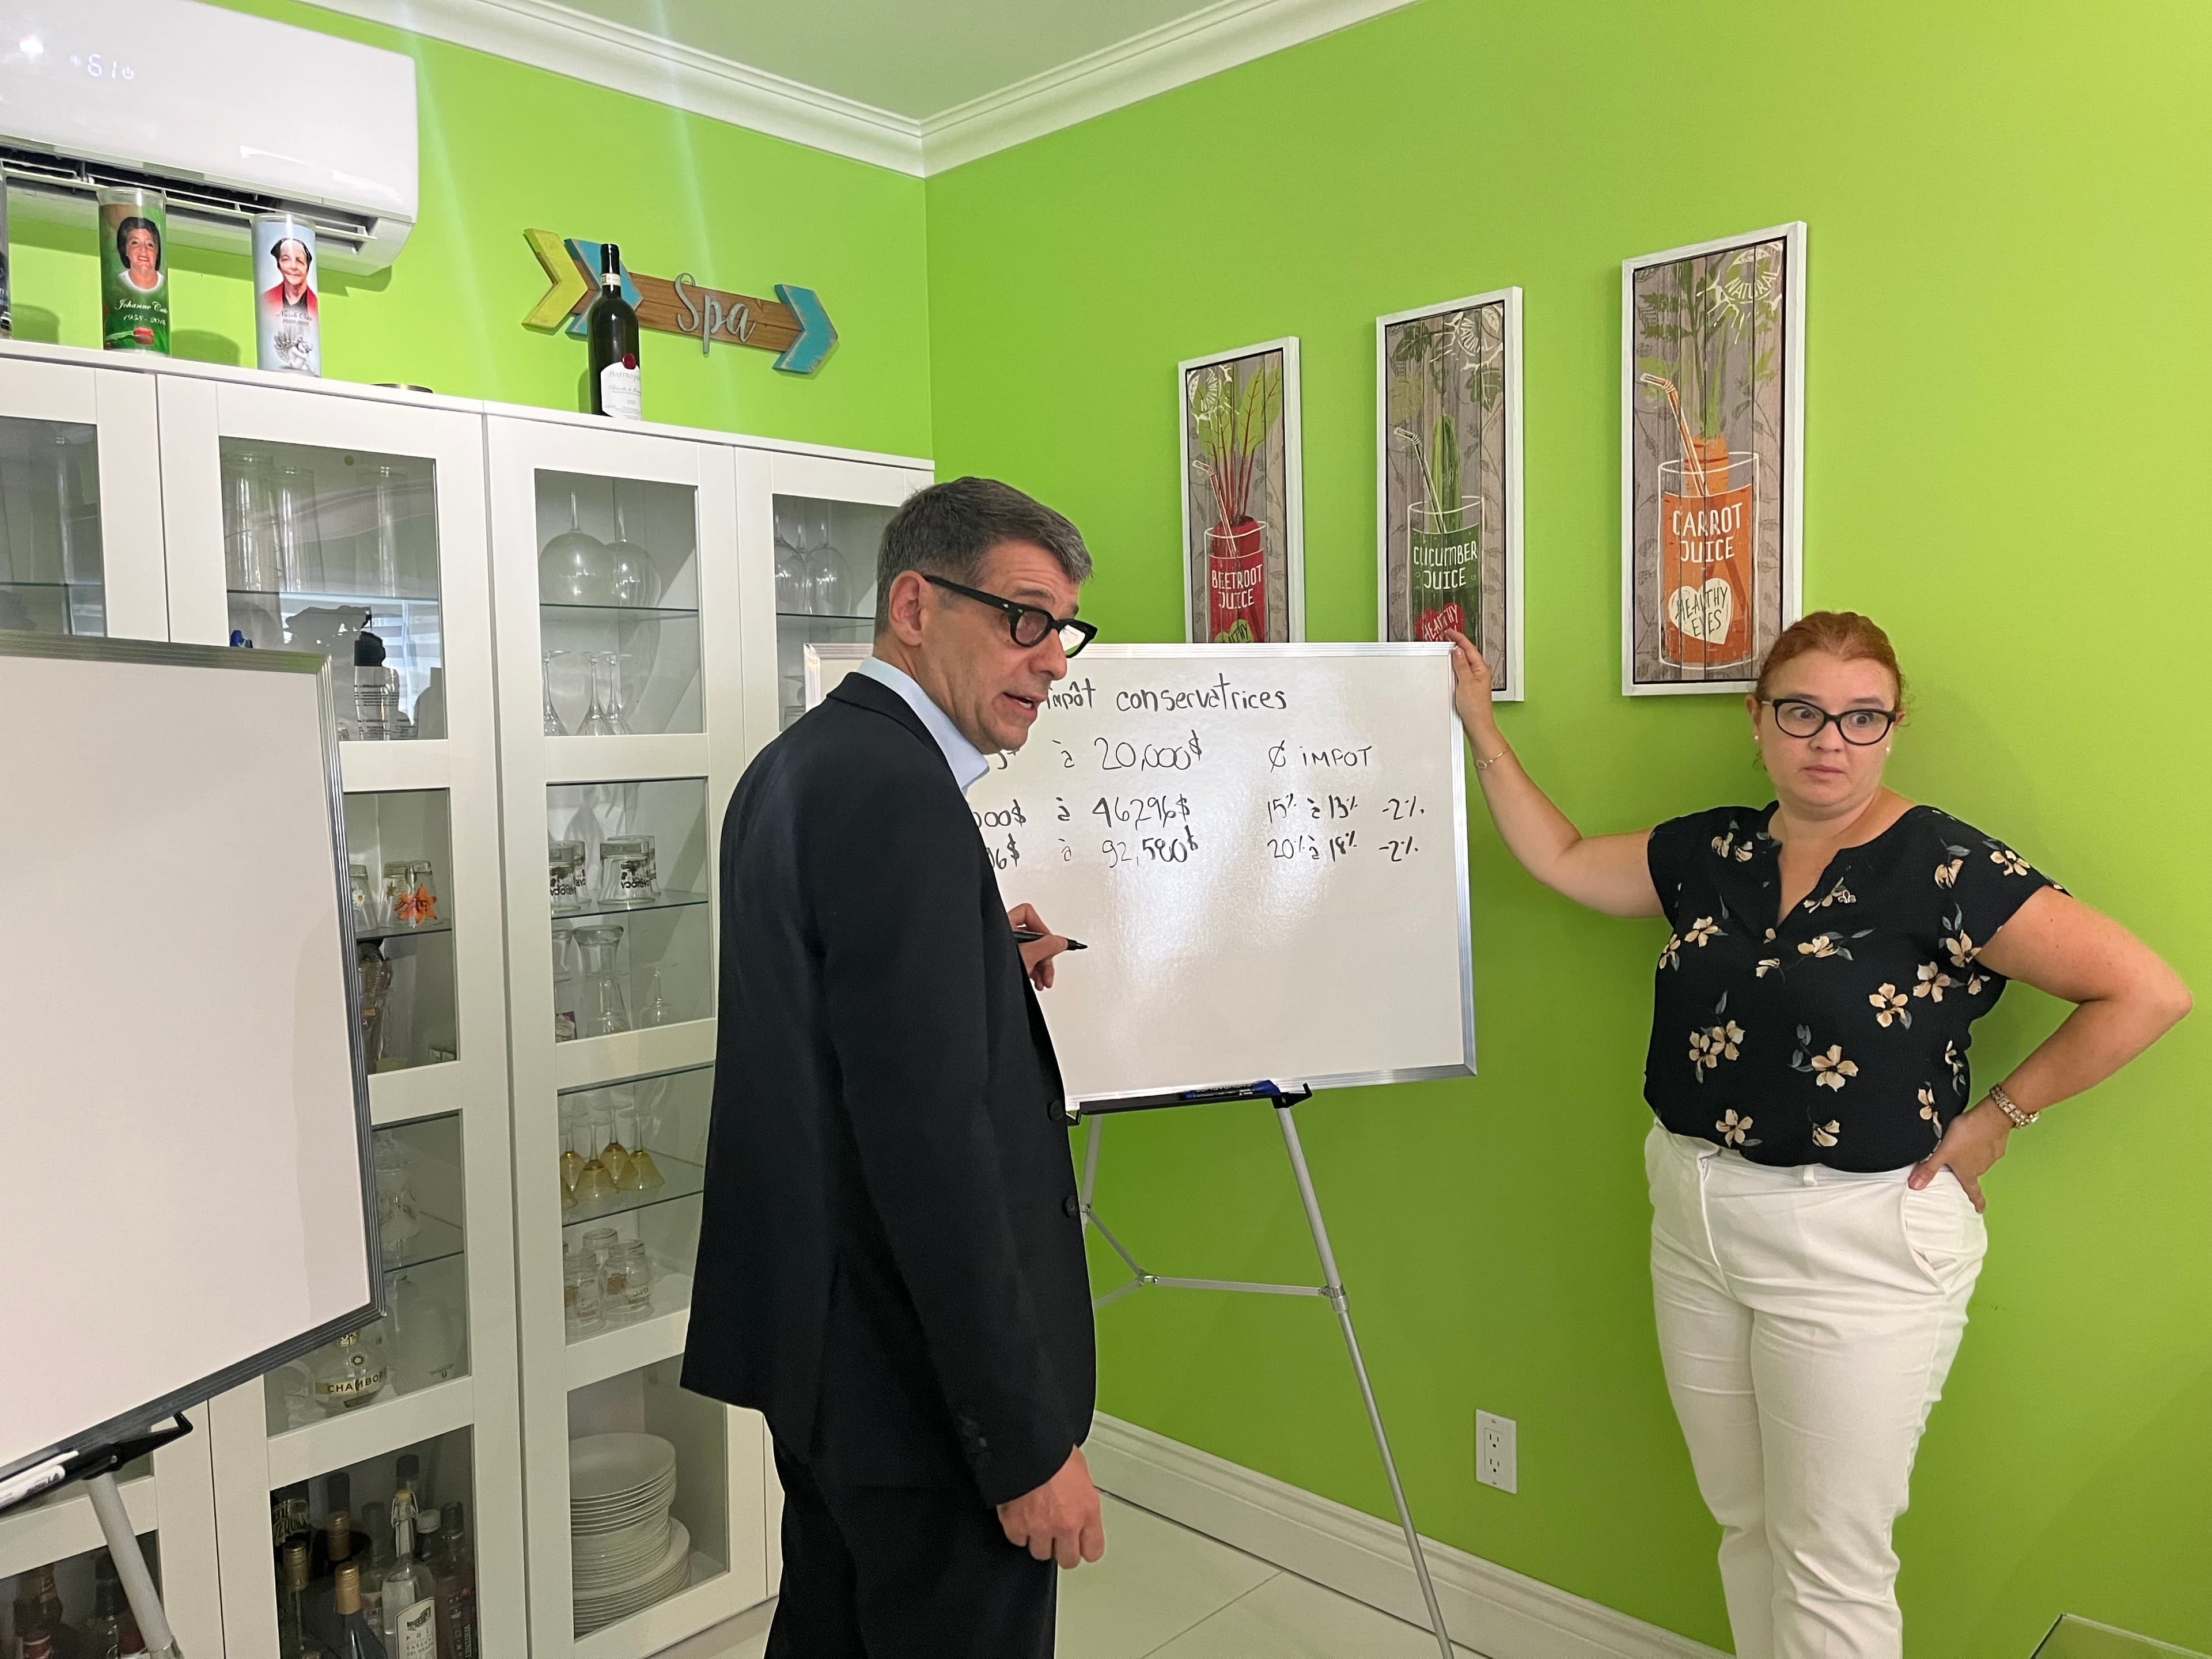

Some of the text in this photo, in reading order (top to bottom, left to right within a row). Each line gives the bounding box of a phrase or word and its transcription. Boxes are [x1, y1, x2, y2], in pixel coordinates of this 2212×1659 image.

[1725, 265, 1781, 300] NATURAL
[674, 272, 756, 354] Spa
[1672, 502, 1743, 537] CARROT
[1414, 540, 1478, 567] CUCUMBER
[1680, 536, 1735, 563] JUICE
[1211, 563, 1263, 589] BEETROOT
[1423, 567, 1466, 589] JUICE
[1218, 588, 1255, 609] JUICE
[1675, 586, 1728, 621] HEALTHY
[1691, 609, 1722, 638] EYES
[1116, 673, 1287, 711] conservatrices
[1052, 739, 1075, 768] à
[1094, 729, 1203, 774] 20,000$
[1055, 797, 1071, 821] à
[1307, 797, 1320, 819] à
[1058, 838, 1072, 862] à
